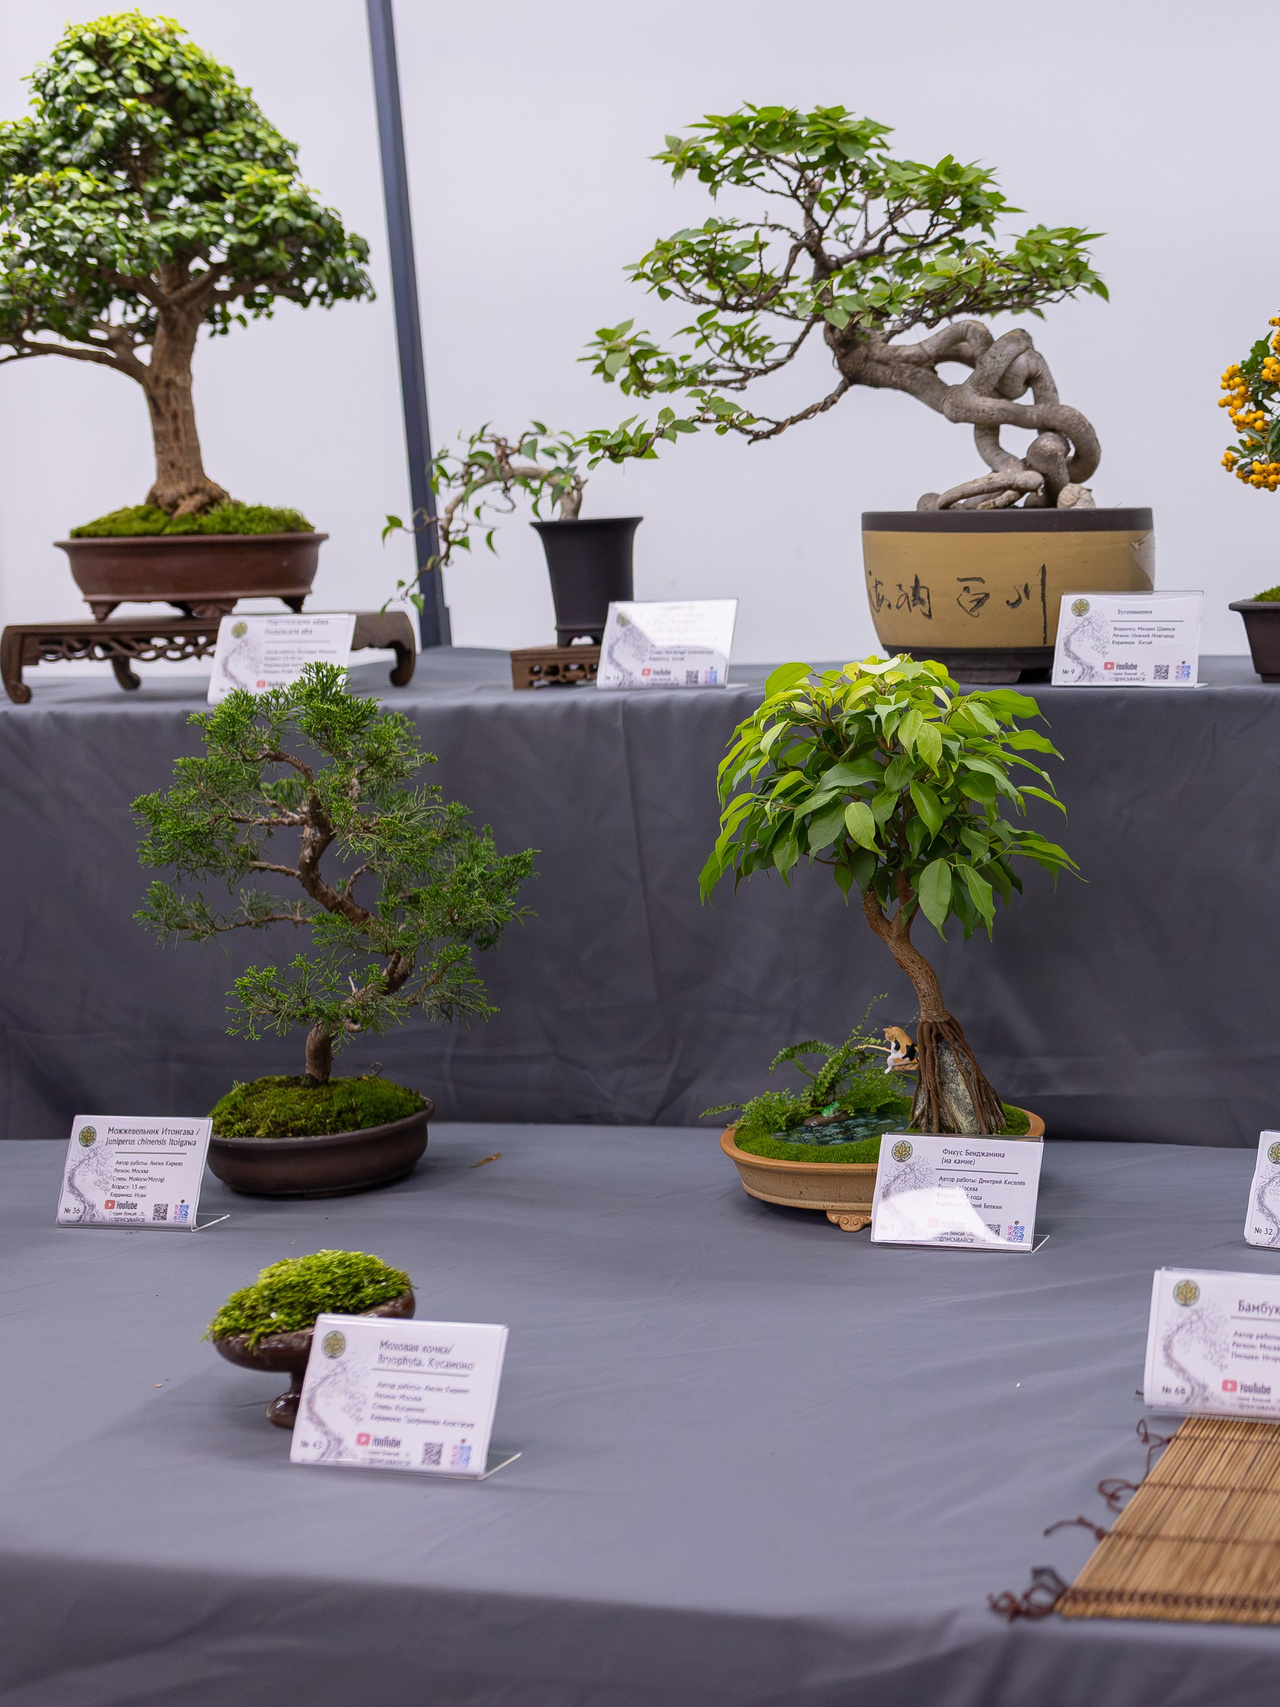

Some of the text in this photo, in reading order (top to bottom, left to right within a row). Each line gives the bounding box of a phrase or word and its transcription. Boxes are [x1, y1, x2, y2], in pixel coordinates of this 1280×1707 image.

[107, 1127, 159, 1135] Можжевельник
[105, 1138, 135, 1146] Juniperus
[137, 1138, 166, 1146] chinensis
[942, 1148, 1006, 1158] Фикус Бенджамина
[116, 1201, 138, 1210] YouTube
[1263, 1228, 1273, 1236] 32
[1238, 1300, 1280, 1316] Бамбук
[379, 1340, 418, 1353] Моховая
[428, 1358, 474, 1371] Кусамоно
[1240, 1381, 1271, 1394] YouTube
